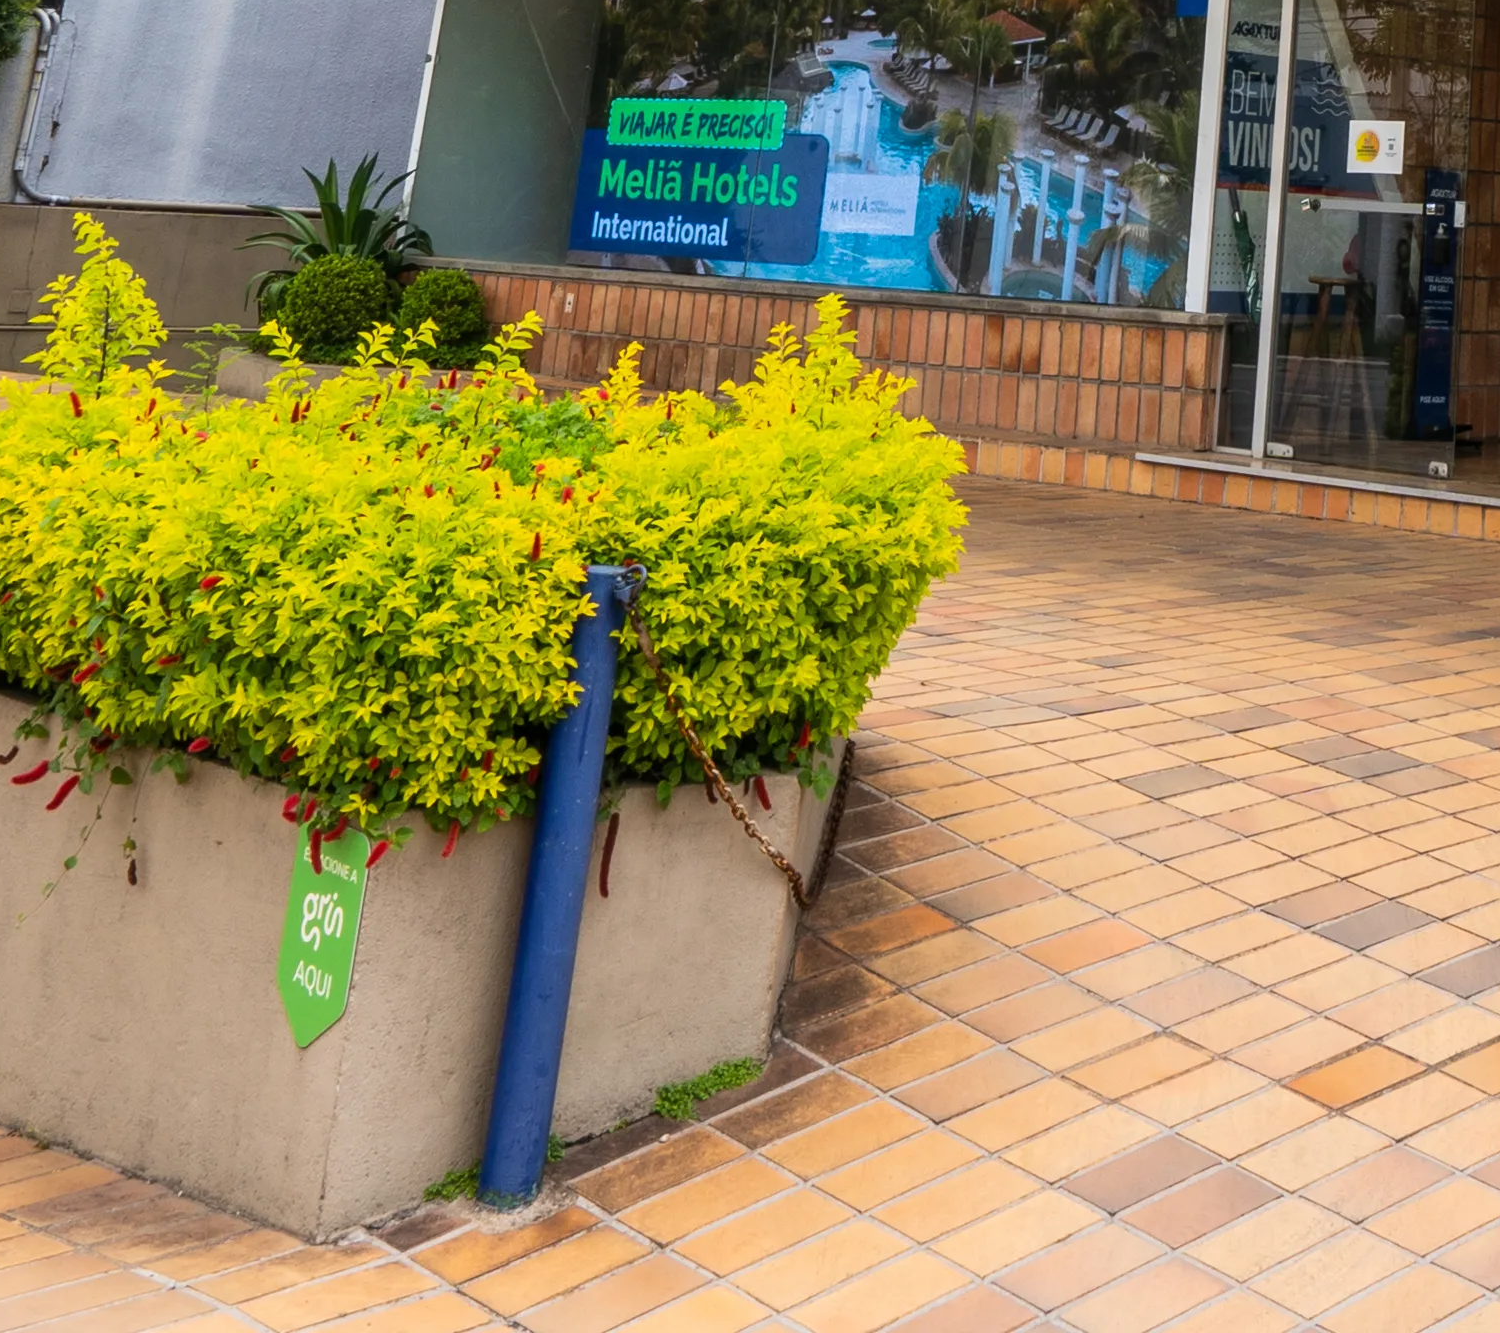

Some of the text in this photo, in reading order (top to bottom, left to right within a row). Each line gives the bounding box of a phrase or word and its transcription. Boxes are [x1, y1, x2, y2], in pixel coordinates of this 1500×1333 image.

[619, 105, 774, 140] VIAJAR É PRECISO!
[598, 158, 799, 208] Meliã Hotels
[592, 210, 729, 247] International
[292, 959, 333, 1000] AQUI
